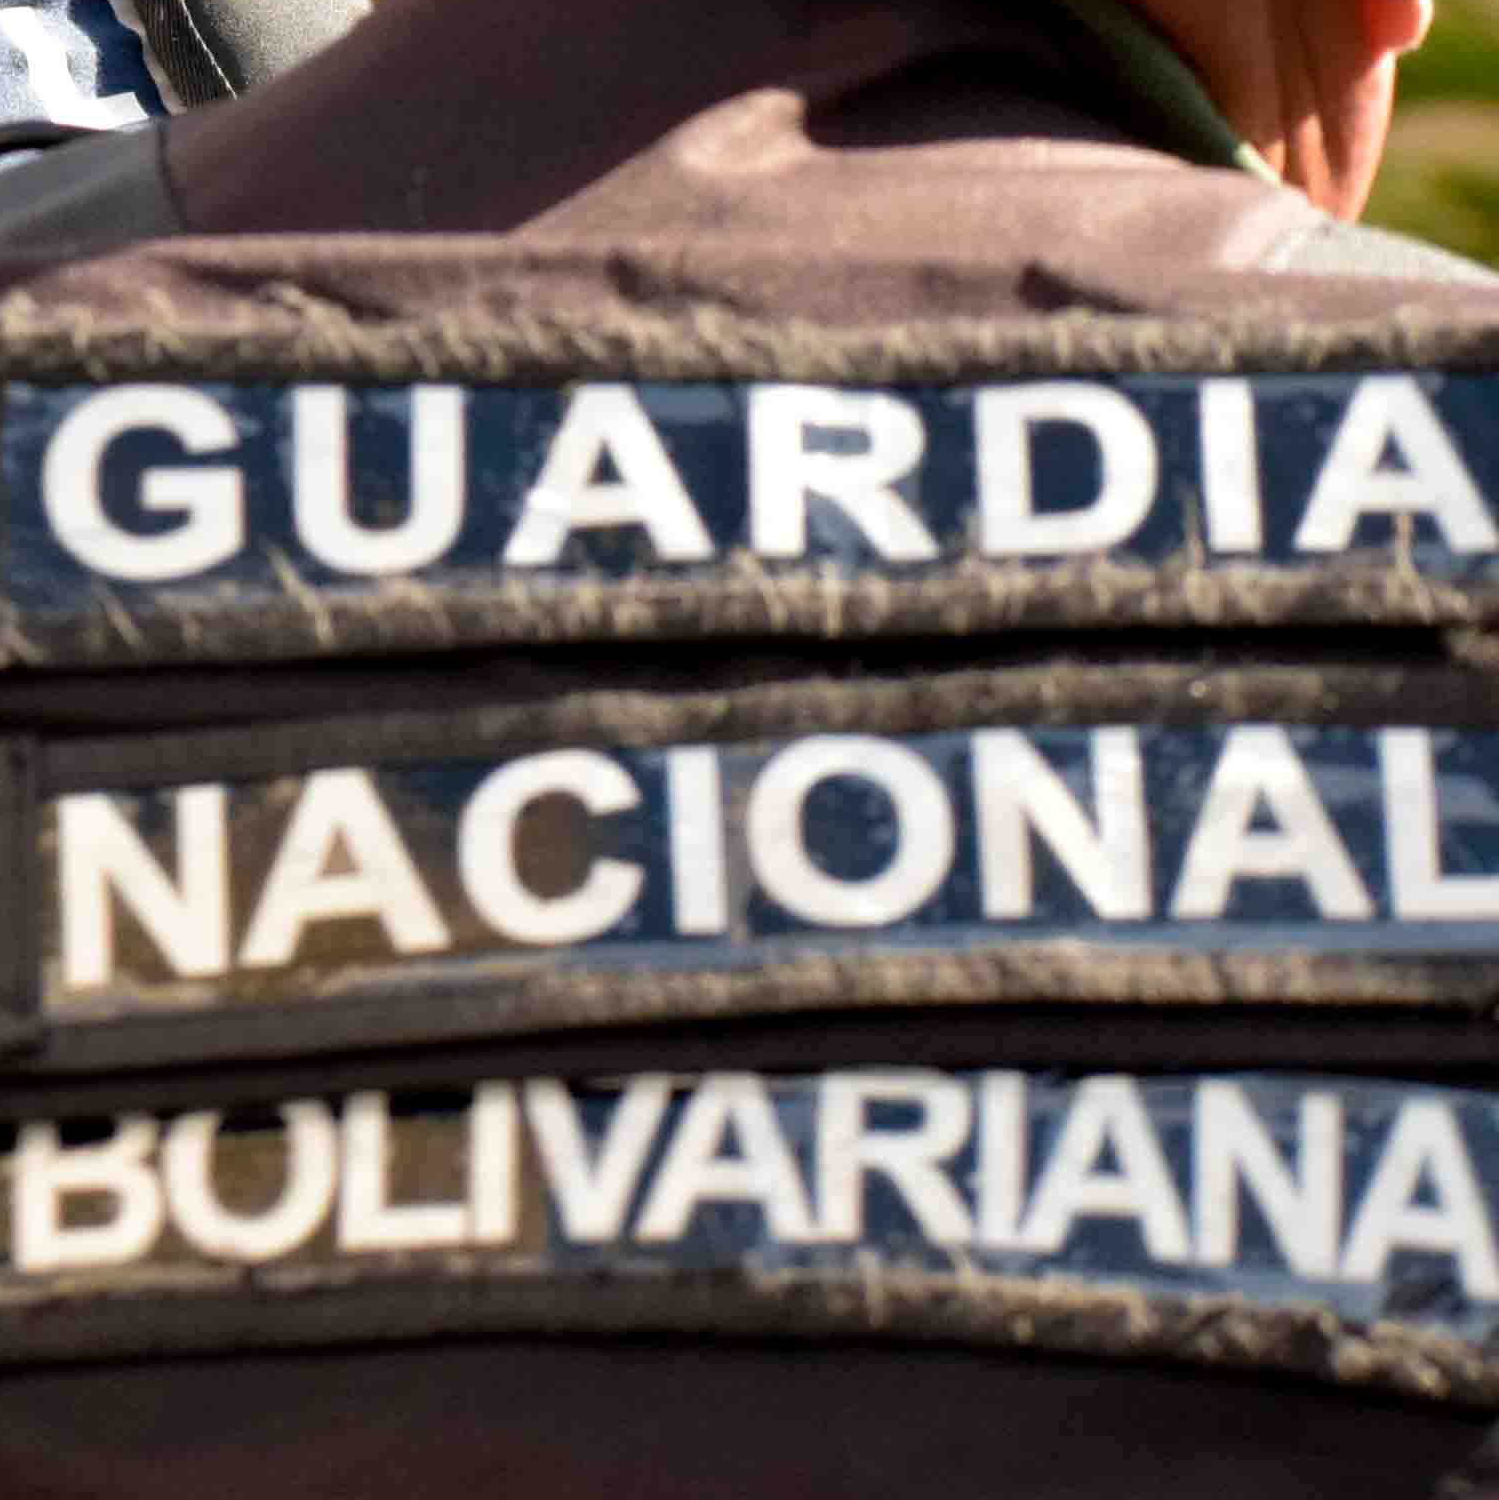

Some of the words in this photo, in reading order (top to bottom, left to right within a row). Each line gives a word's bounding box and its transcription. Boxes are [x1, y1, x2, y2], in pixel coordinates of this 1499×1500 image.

[42, 376, 1498, 581] GUARDIA
[57, 724, 1499, 987] NACIONAL
[12, 1068, 1499, 1301] BOLIVARIANA
